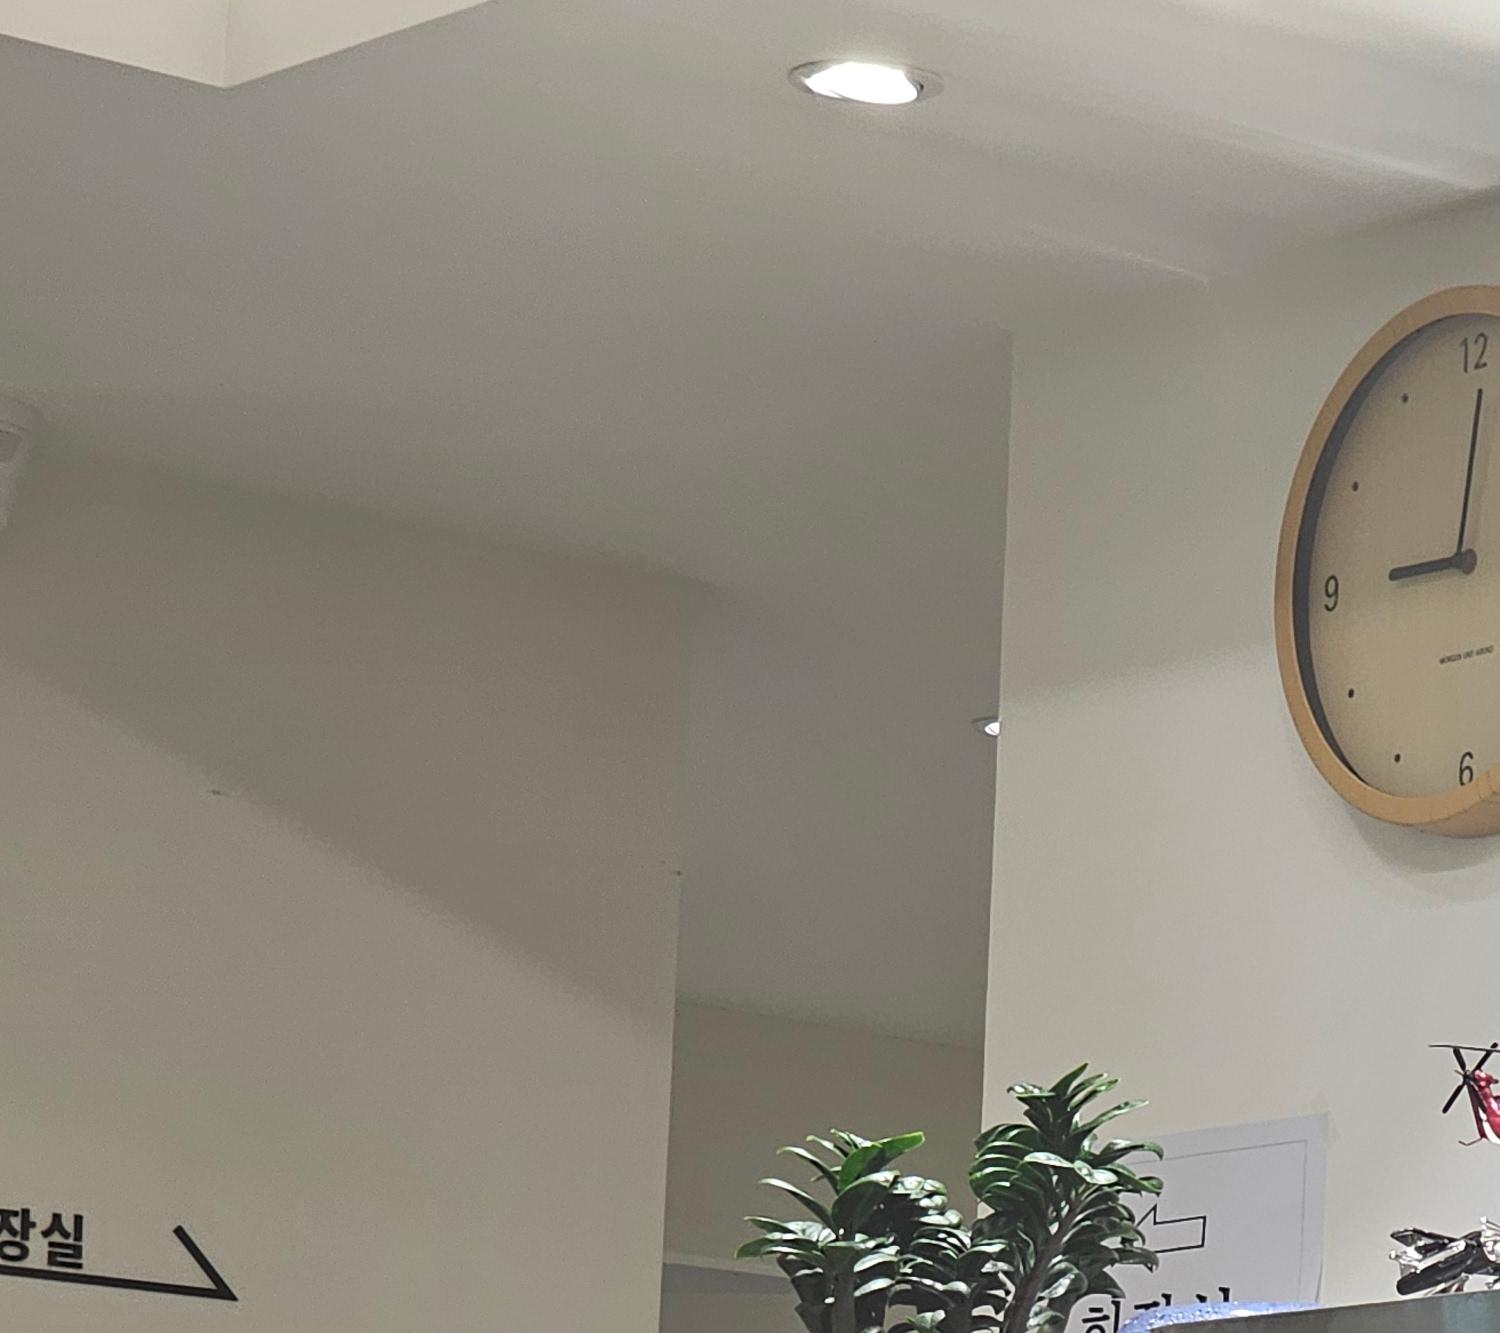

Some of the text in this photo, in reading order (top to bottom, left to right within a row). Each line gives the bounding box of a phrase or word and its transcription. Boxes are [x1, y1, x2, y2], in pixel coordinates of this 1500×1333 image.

[1459, 332, 1488, 374] 12
[1324, 575, 1339, 612] 9
[1459, 751, 1474, 787] 6
[0, 1208, 84, 1269] 장실
